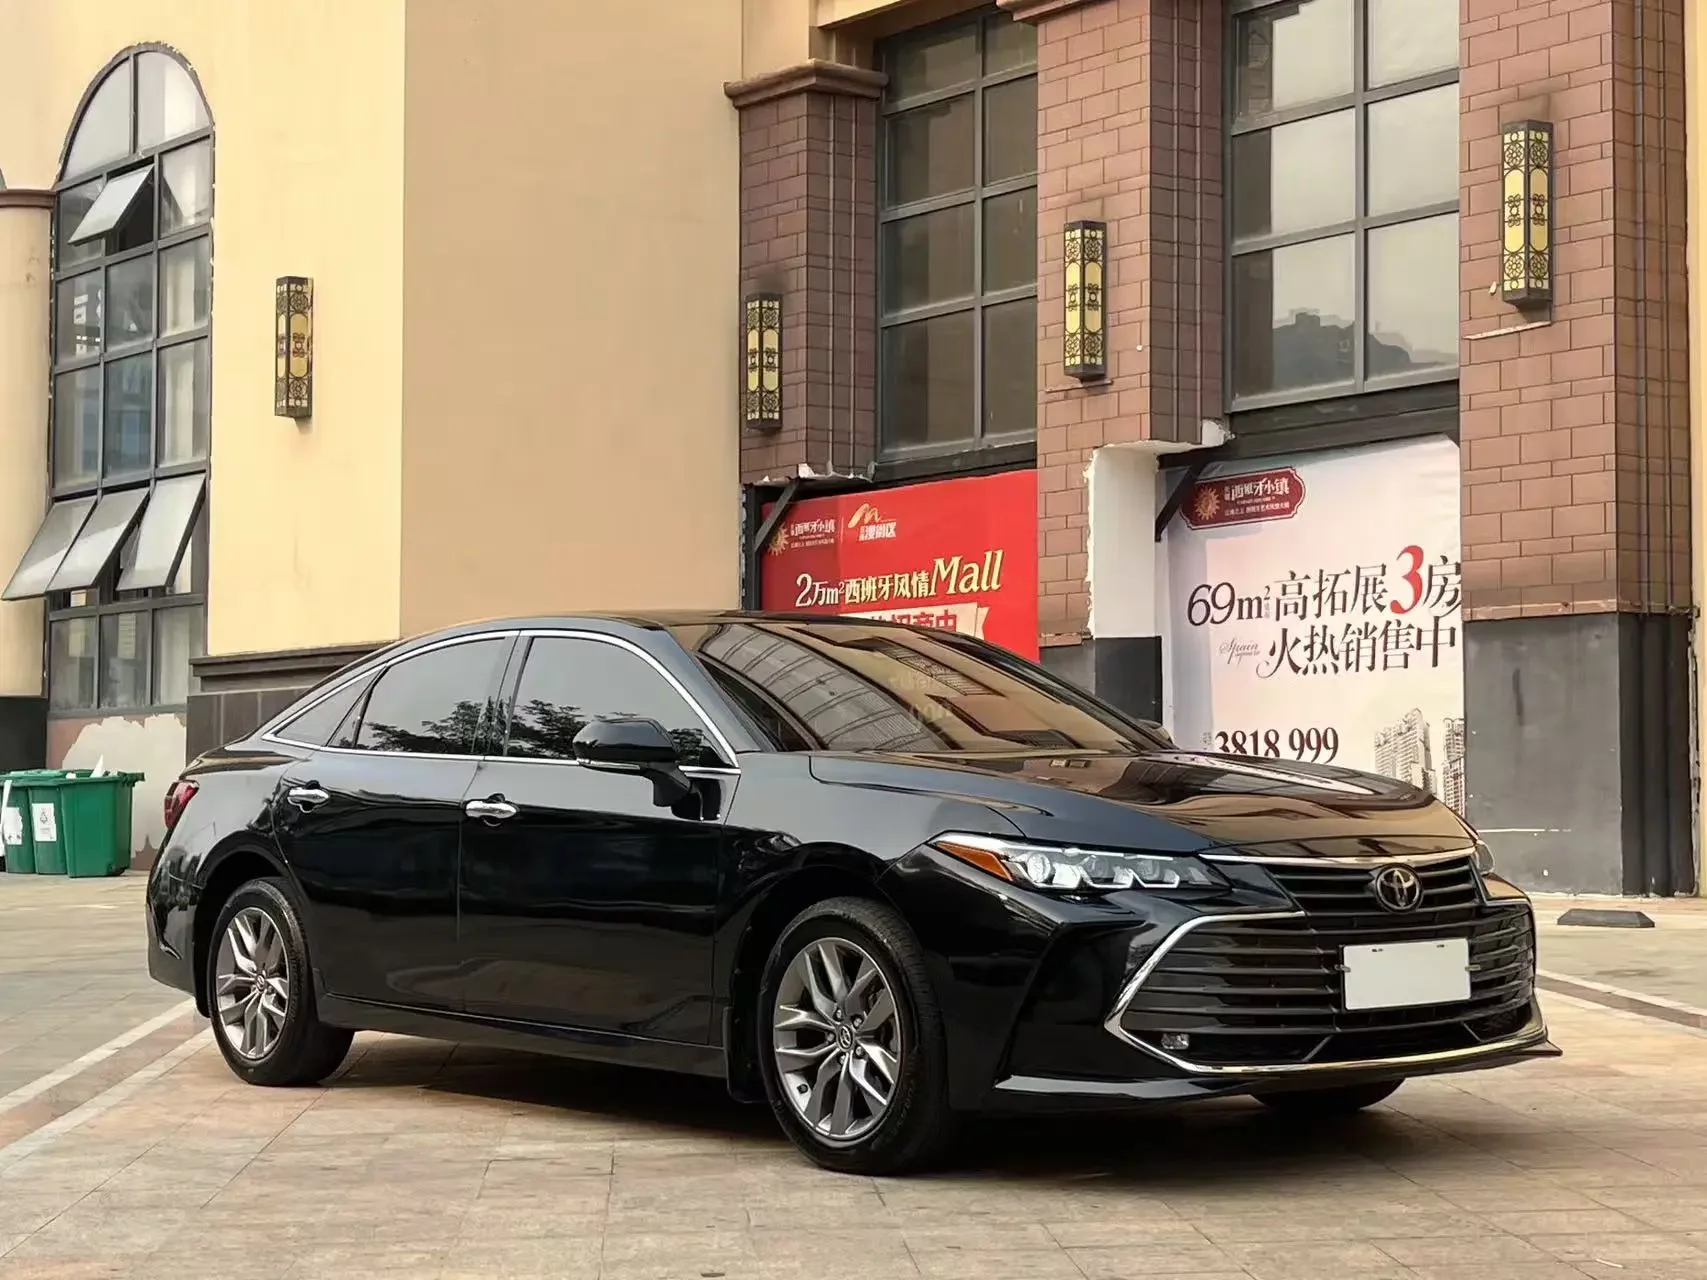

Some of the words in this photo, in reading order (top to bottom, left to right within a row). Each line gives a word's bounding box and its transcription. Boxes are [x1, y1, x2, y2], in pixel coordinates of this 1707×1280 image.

[1256, 616, 1456, 679] 火热销售中
[1288, 727, 1339, 764] 999
